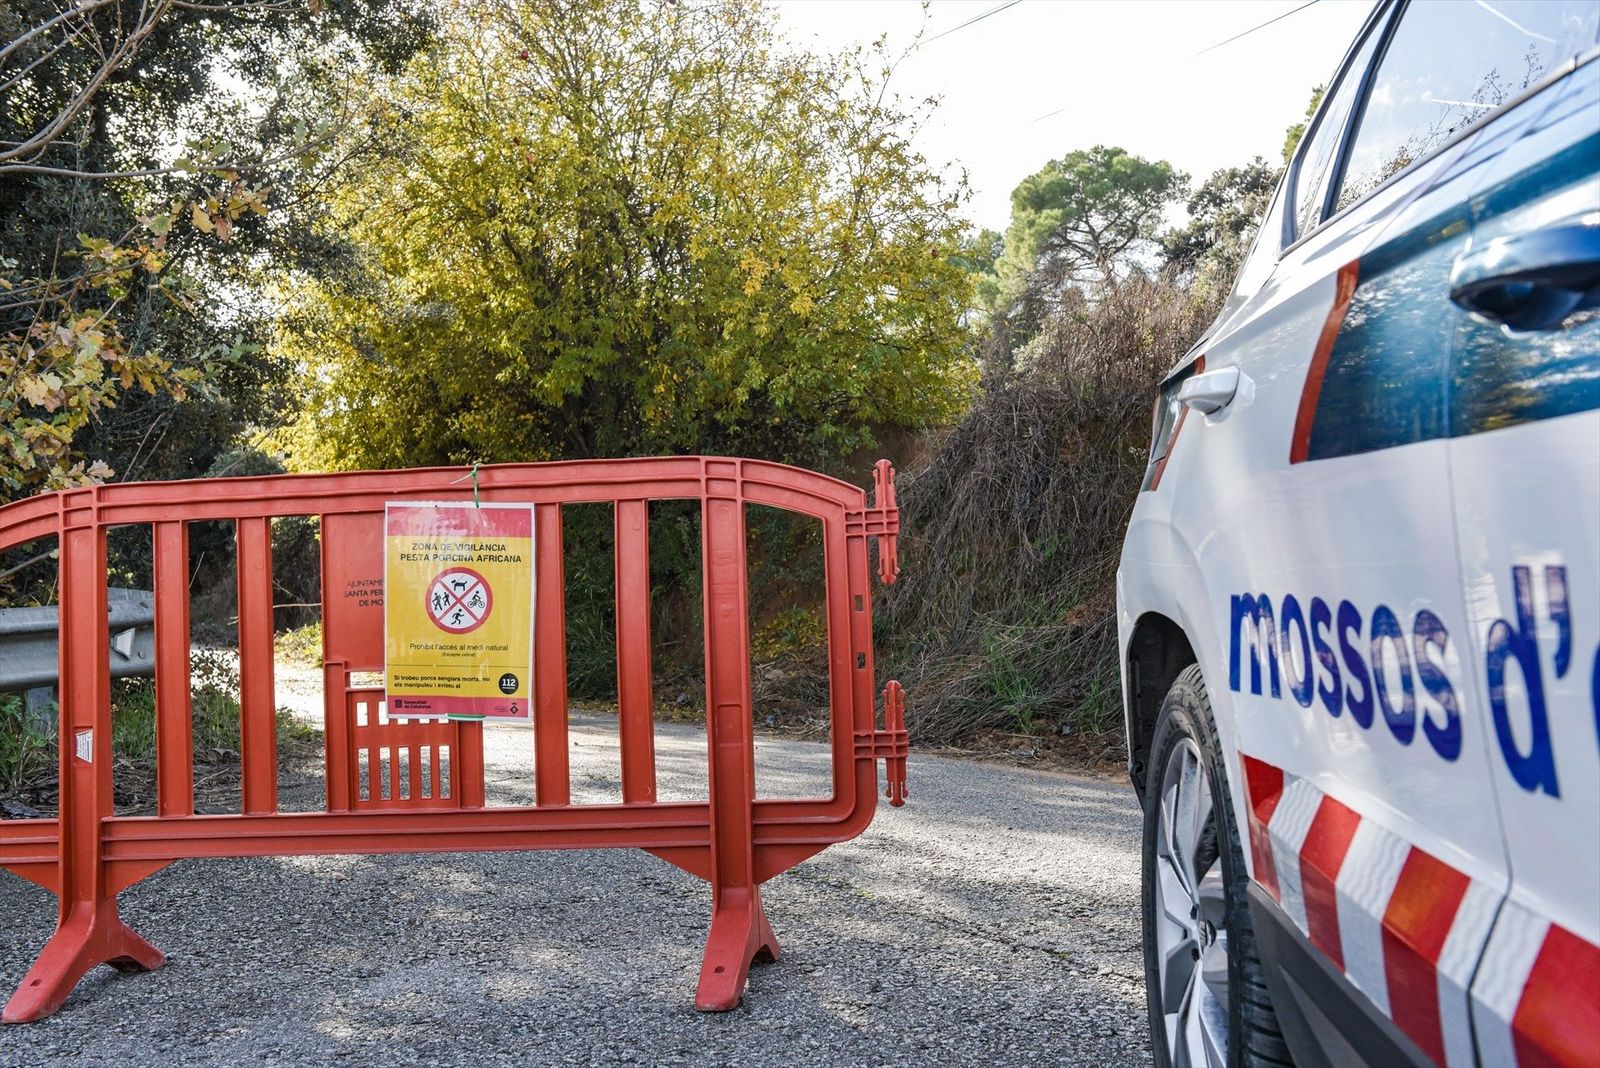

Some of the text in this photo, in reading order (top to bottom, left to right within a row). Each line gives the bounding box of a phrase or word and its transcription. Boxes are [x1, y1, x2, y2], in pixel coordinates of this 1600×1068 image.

[455, 542, 506, 552] VIGILÀNCIA
[476, 554, 522, 562] AFRICANA
[502, 678, 516, 686] 112
[1229, 592, 1462, 763] mossos
